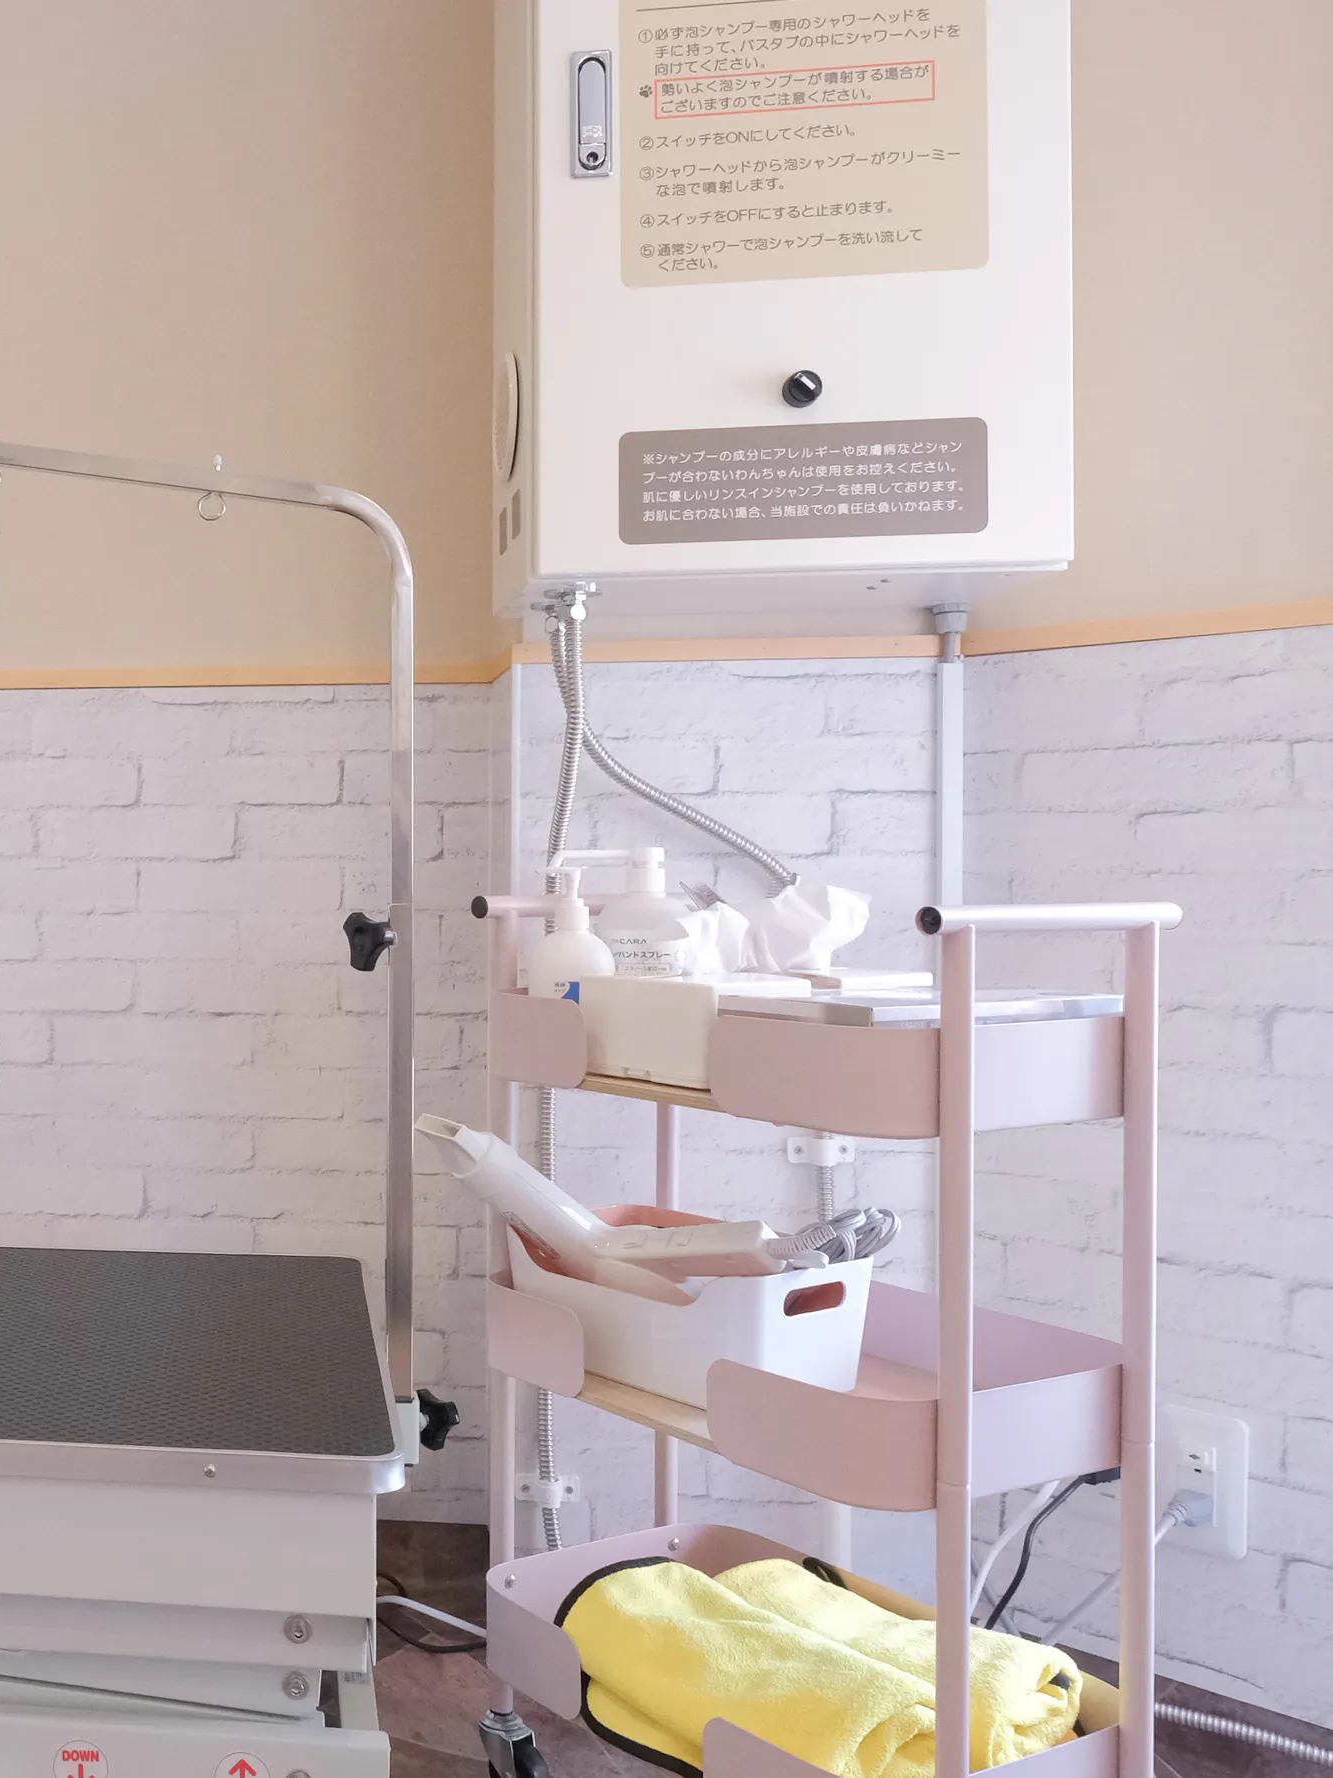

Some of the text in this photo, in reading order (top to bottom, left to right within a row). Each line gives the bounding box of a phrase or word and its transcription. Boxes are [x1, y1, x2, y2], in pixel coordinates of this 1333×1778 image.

[654, 57, 765, 76] 向けてください。
[661, 88, 872, 114] ございますのでご注意ください。
[639, 124, 855, 150] ②スイッチをONにしてください。
[656, 177, 785, 197] な泡で噴射します。
[658, 257, 718, 272] ください。
[62, 1749, 99, 1762] DOWN
